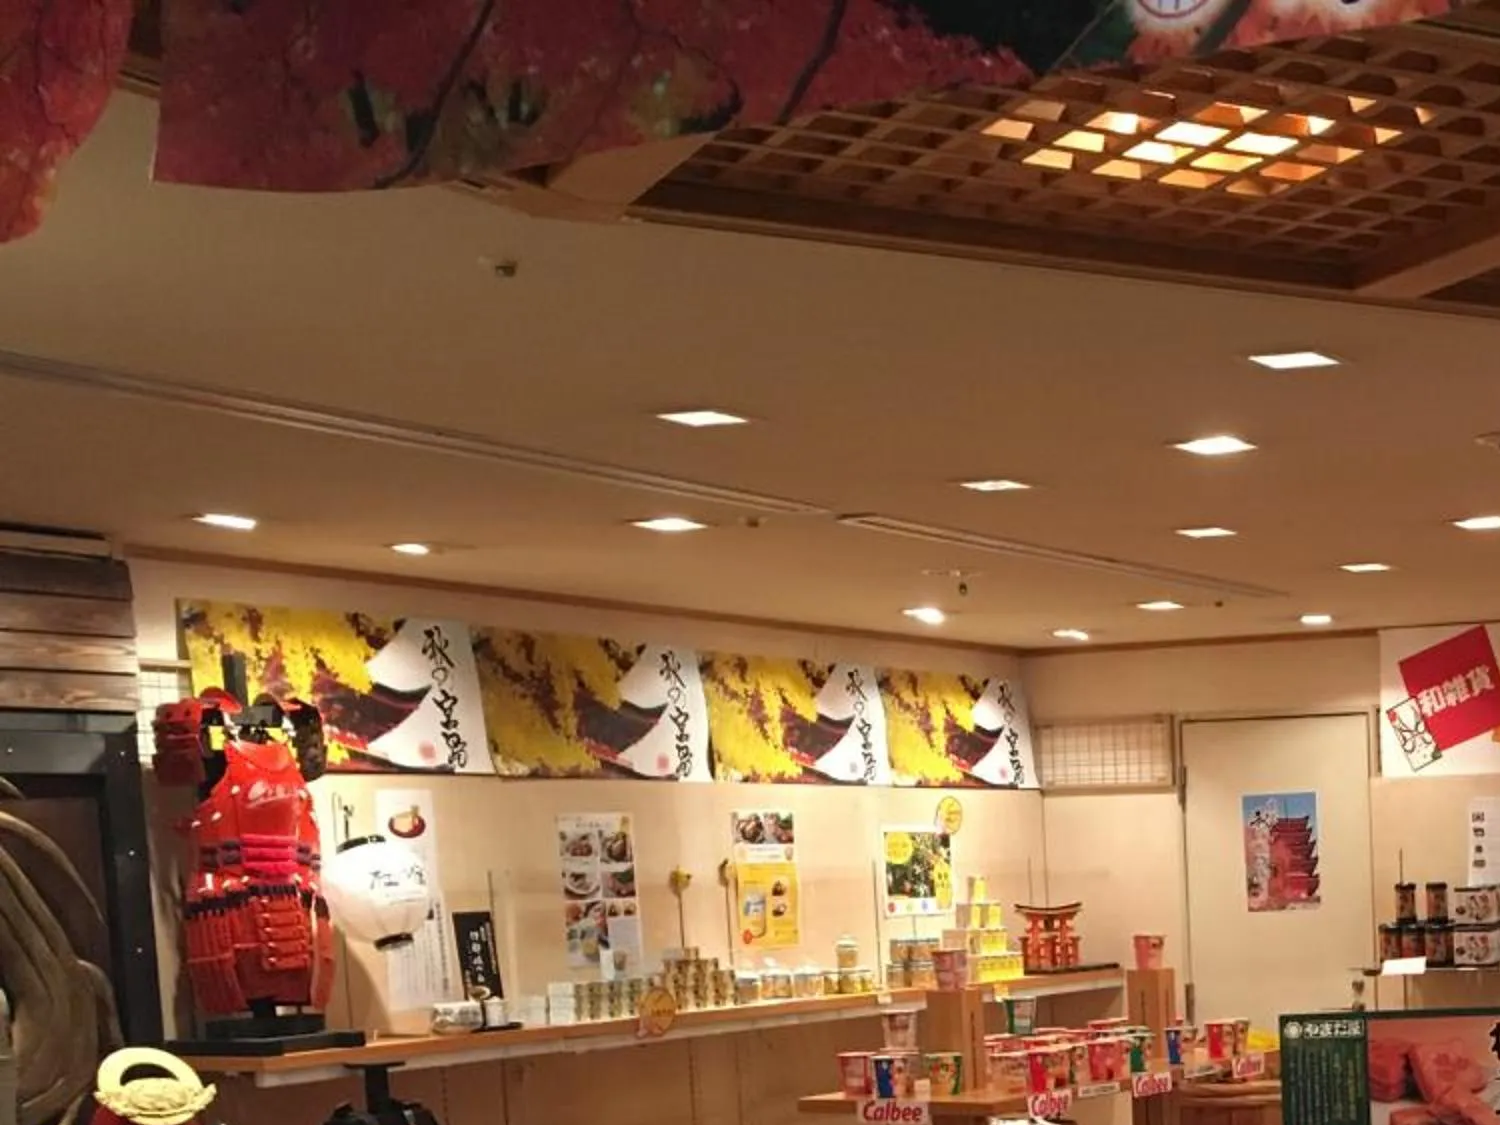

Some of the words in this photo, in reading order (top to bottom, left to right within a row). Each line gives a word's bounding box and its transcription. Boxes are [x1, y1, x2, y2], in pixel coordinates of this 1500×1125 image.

[1416, 664, 1495, 717] 和雑貨
[863, 1100, 923, 1122] Calbee
